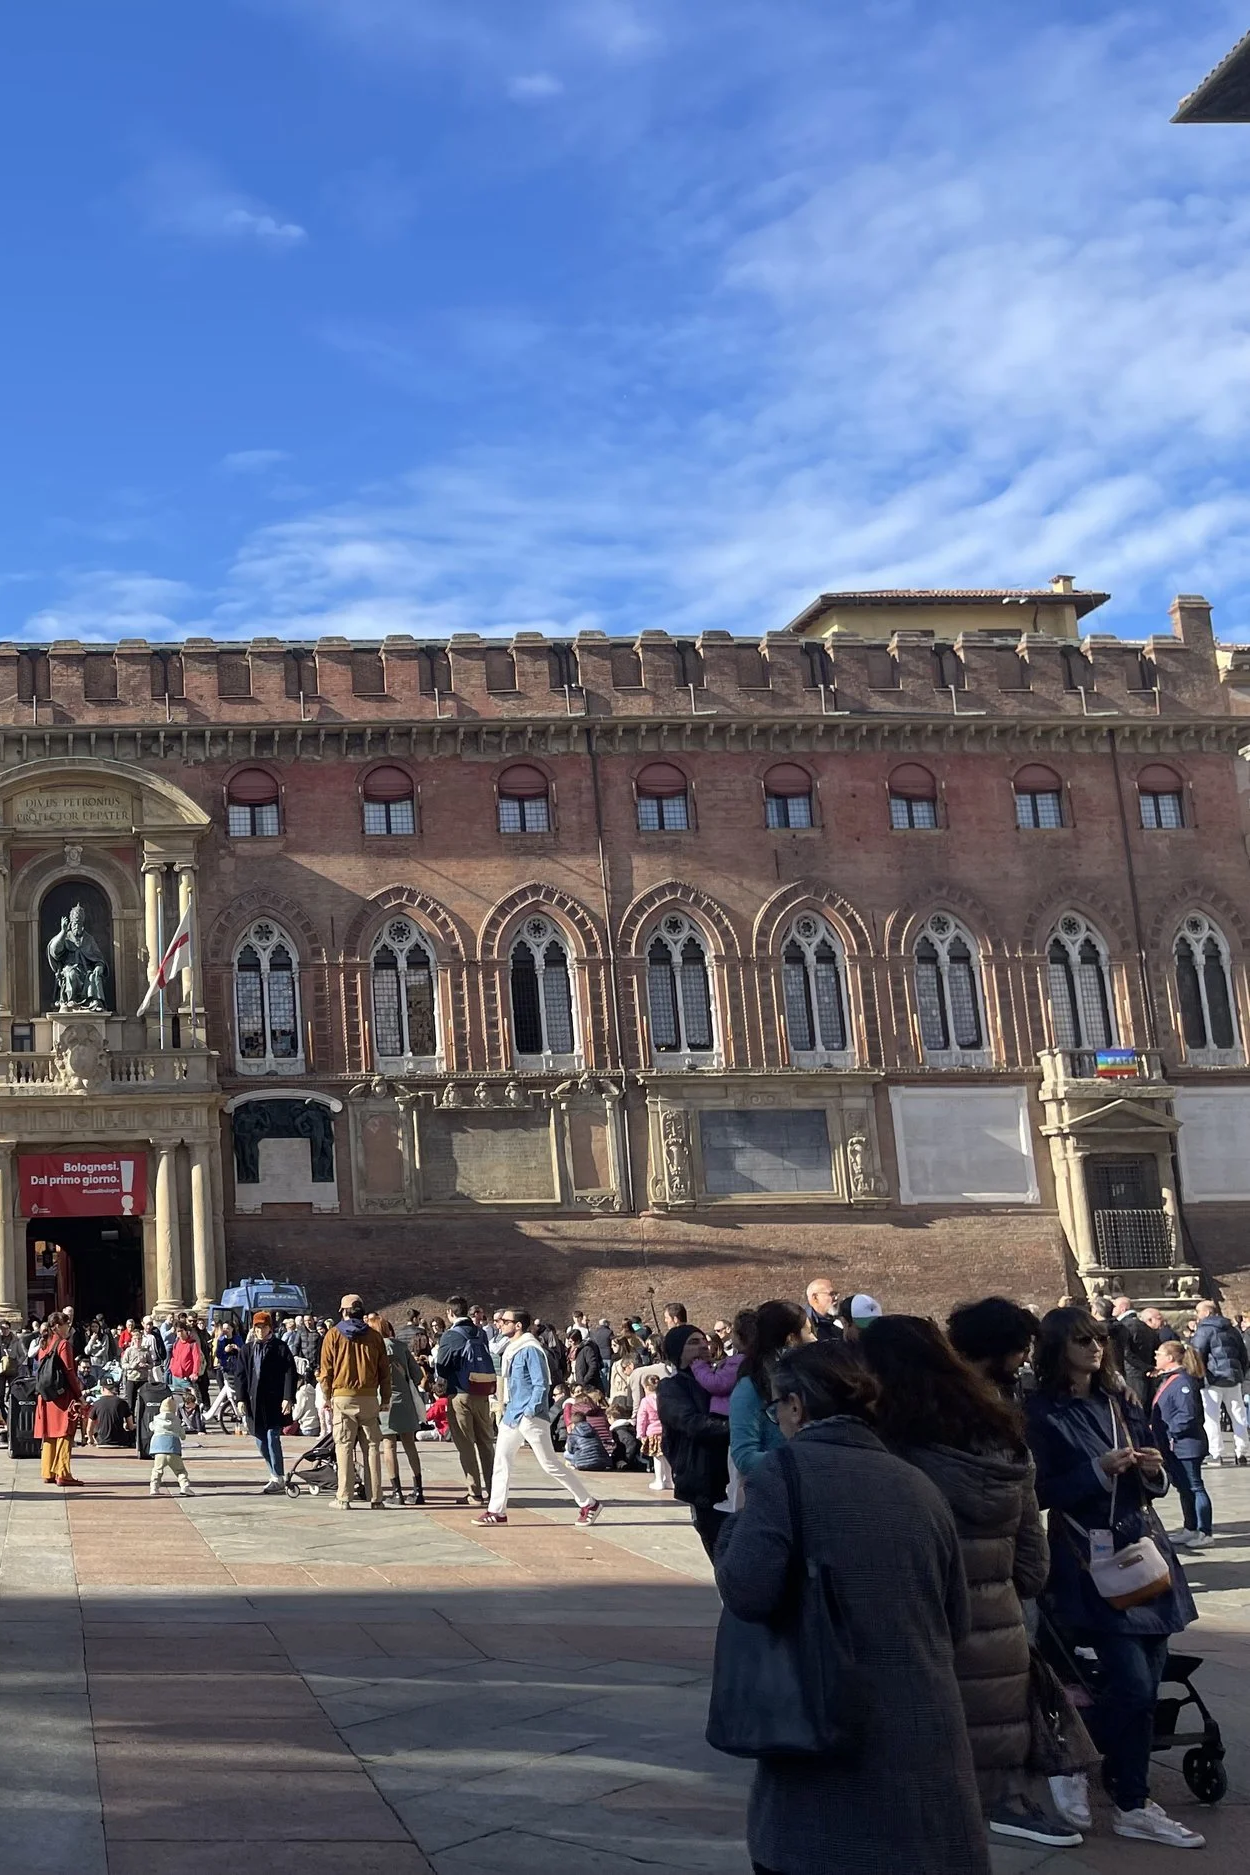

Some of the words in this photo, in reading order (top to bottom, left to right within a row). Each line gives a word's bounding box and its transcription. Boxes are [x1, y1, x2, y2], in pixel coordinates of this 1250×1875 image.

[63, 1161, 120, 1173] Bolognesi.
[30, 1175, 48, 1185] Dal
[49, 1174, 81, 1187] primo
[82, 1174, 120, 1187] giorno.
